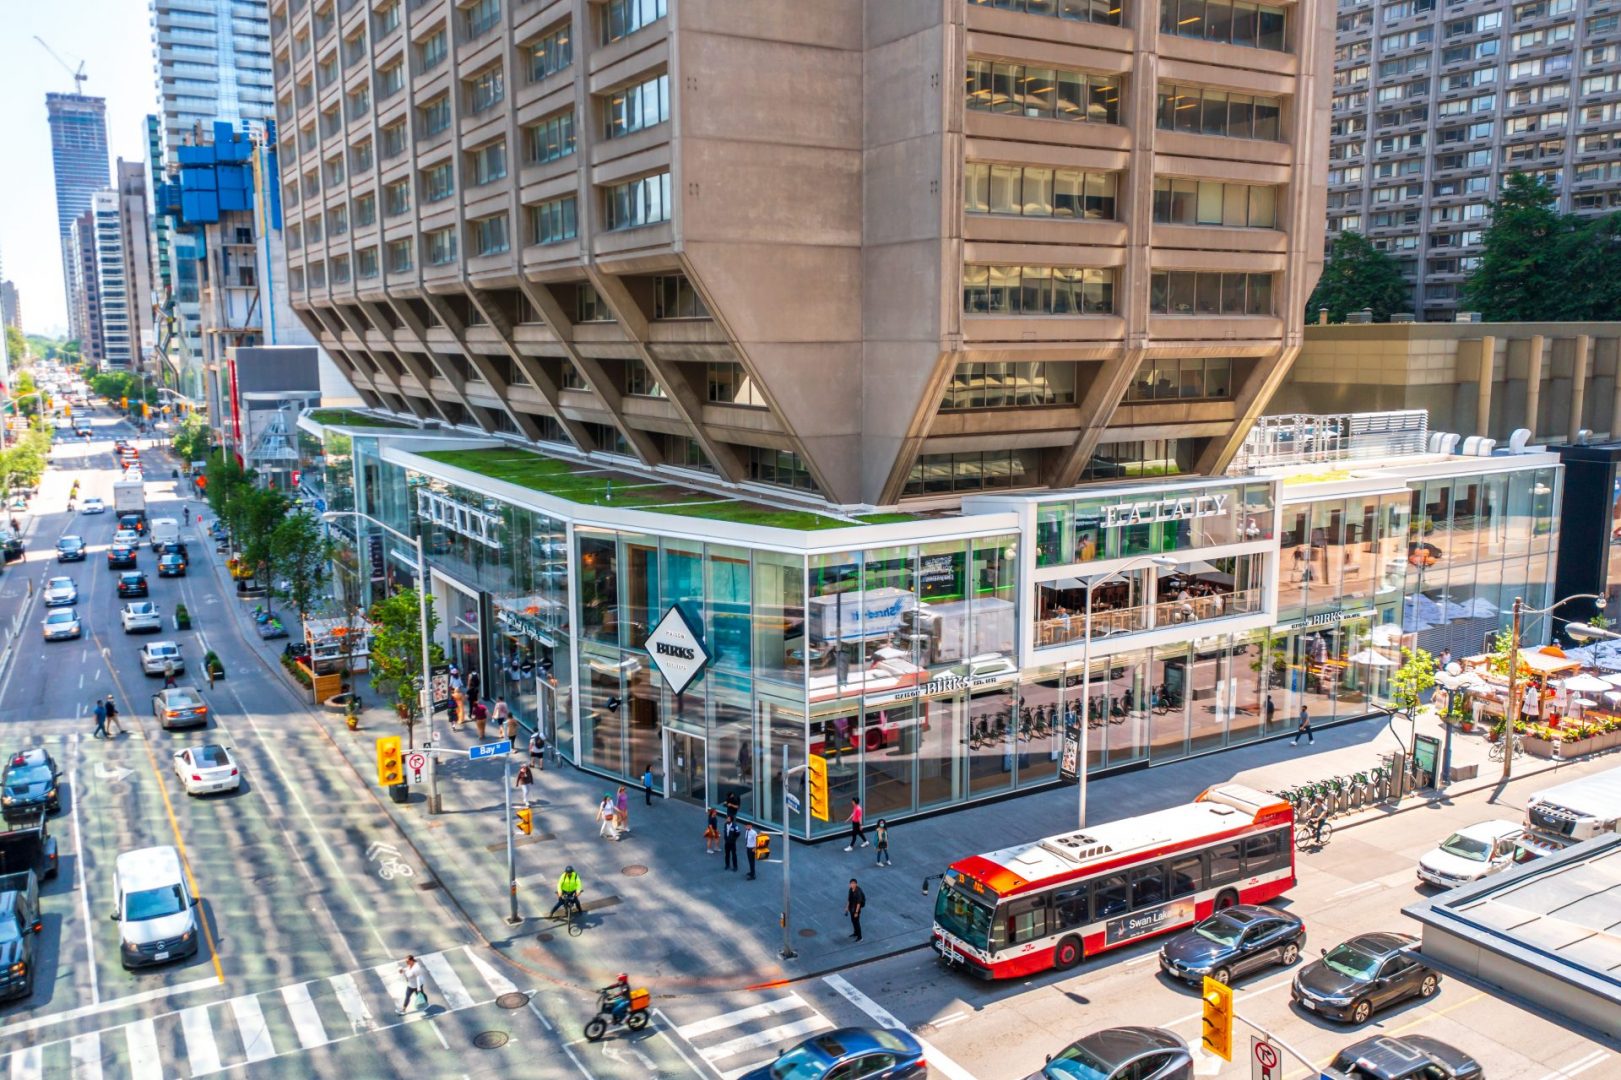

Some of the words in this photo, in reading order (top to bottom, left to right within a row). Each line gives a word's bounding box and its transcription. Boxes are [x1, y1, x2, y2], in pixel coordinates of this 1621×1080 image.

[1101, 494, 1228, 528] EATALY
[1312, 610, 1343, 625] BIRKS
[656, 642, 694, 660] BIRKS
[924, 675, 970, 694] BIRKS
[480, 746, 495, 755] Bay
[1129, 916, 1152, 929] Swan
